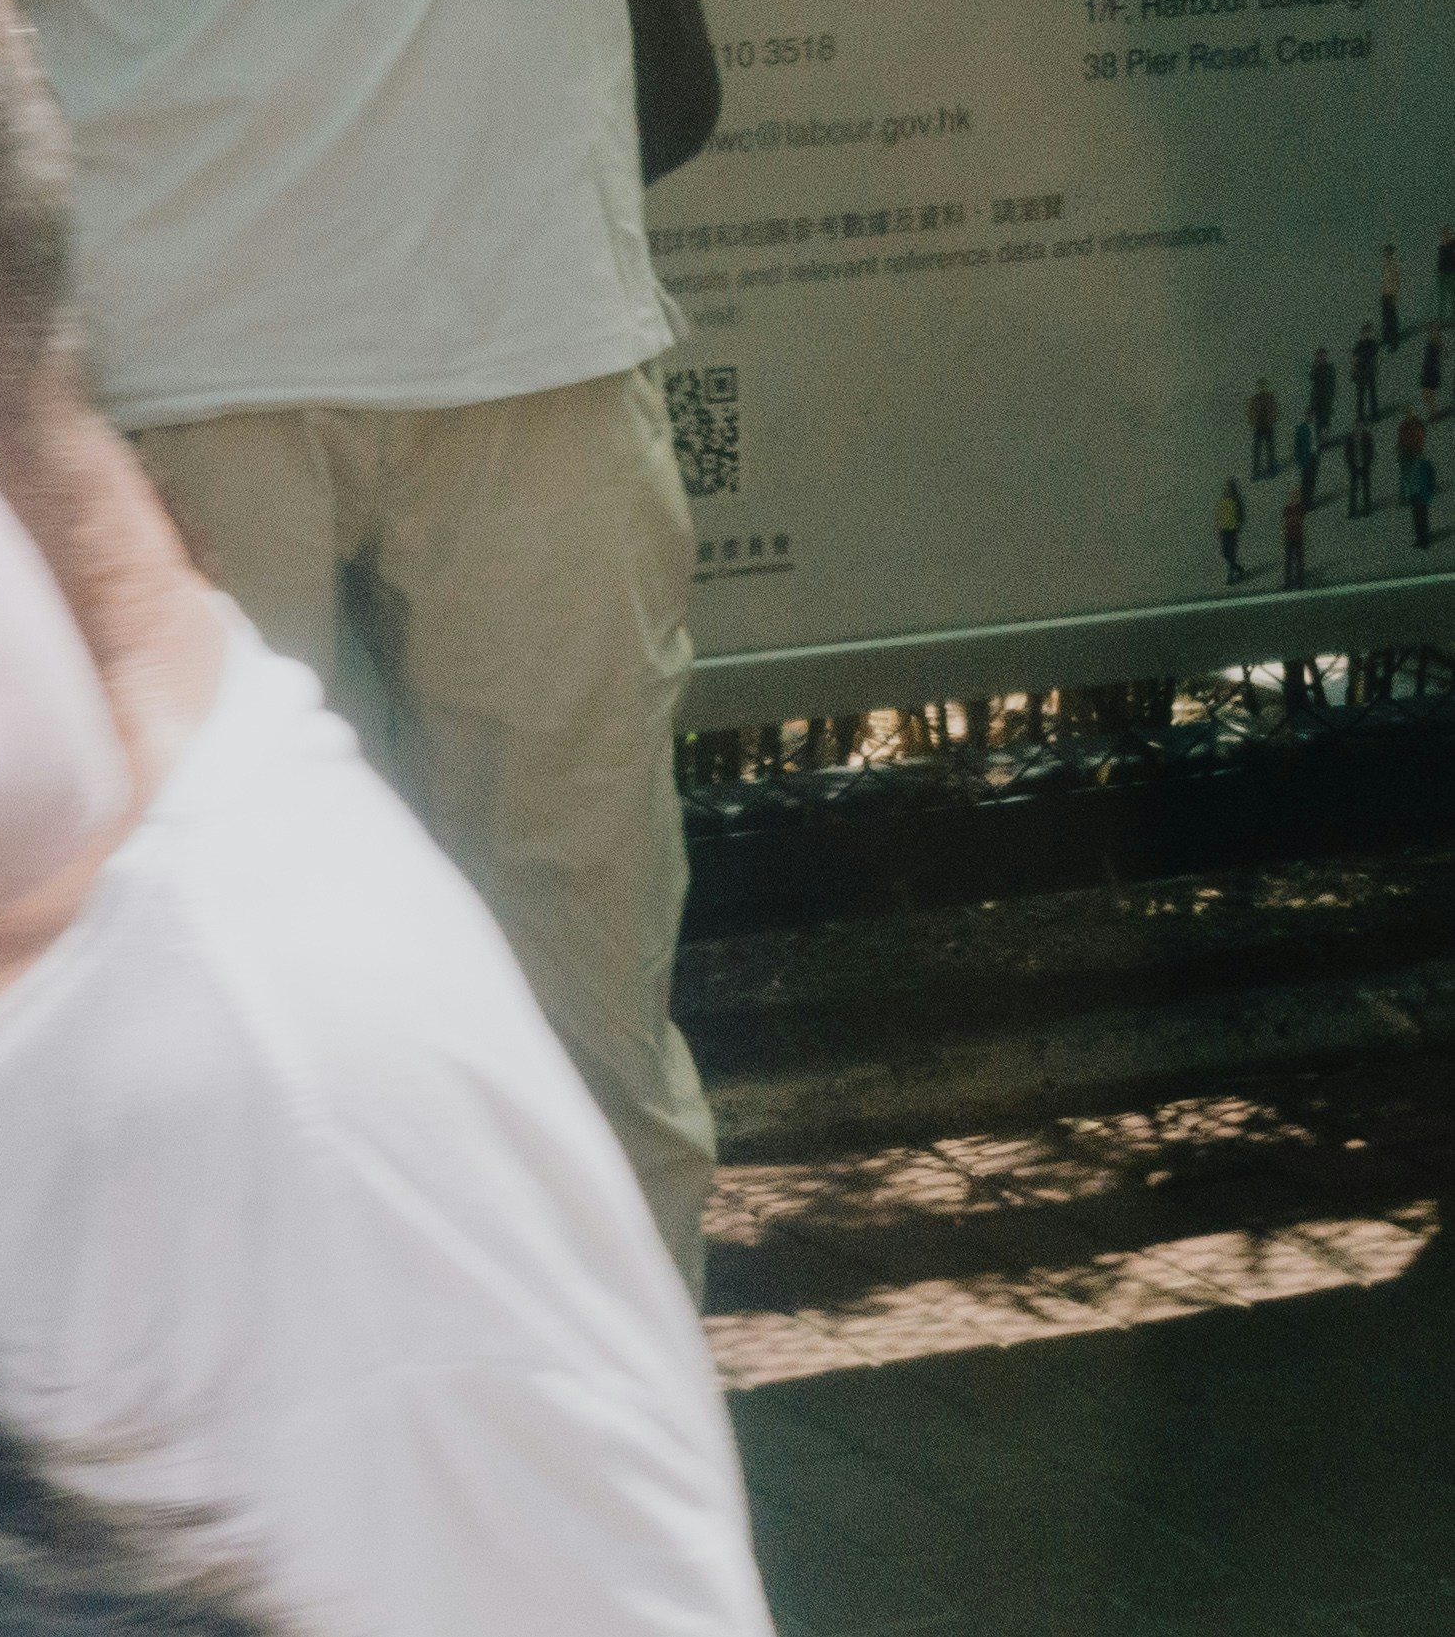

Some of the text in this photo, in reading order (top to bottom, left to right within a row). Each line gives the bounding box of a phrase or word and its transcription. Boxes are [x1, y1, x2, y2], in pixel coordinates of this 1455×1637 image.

[715, 32, 839, 70] 10 3518
[1083, 52, 1119, 84] 38
[1125, 47, 1182, 79] Pier
[1274, 30, 1375, 67] Central
[997, 238, 1047, 263] data
[1051, 234, 1093, 260] and
